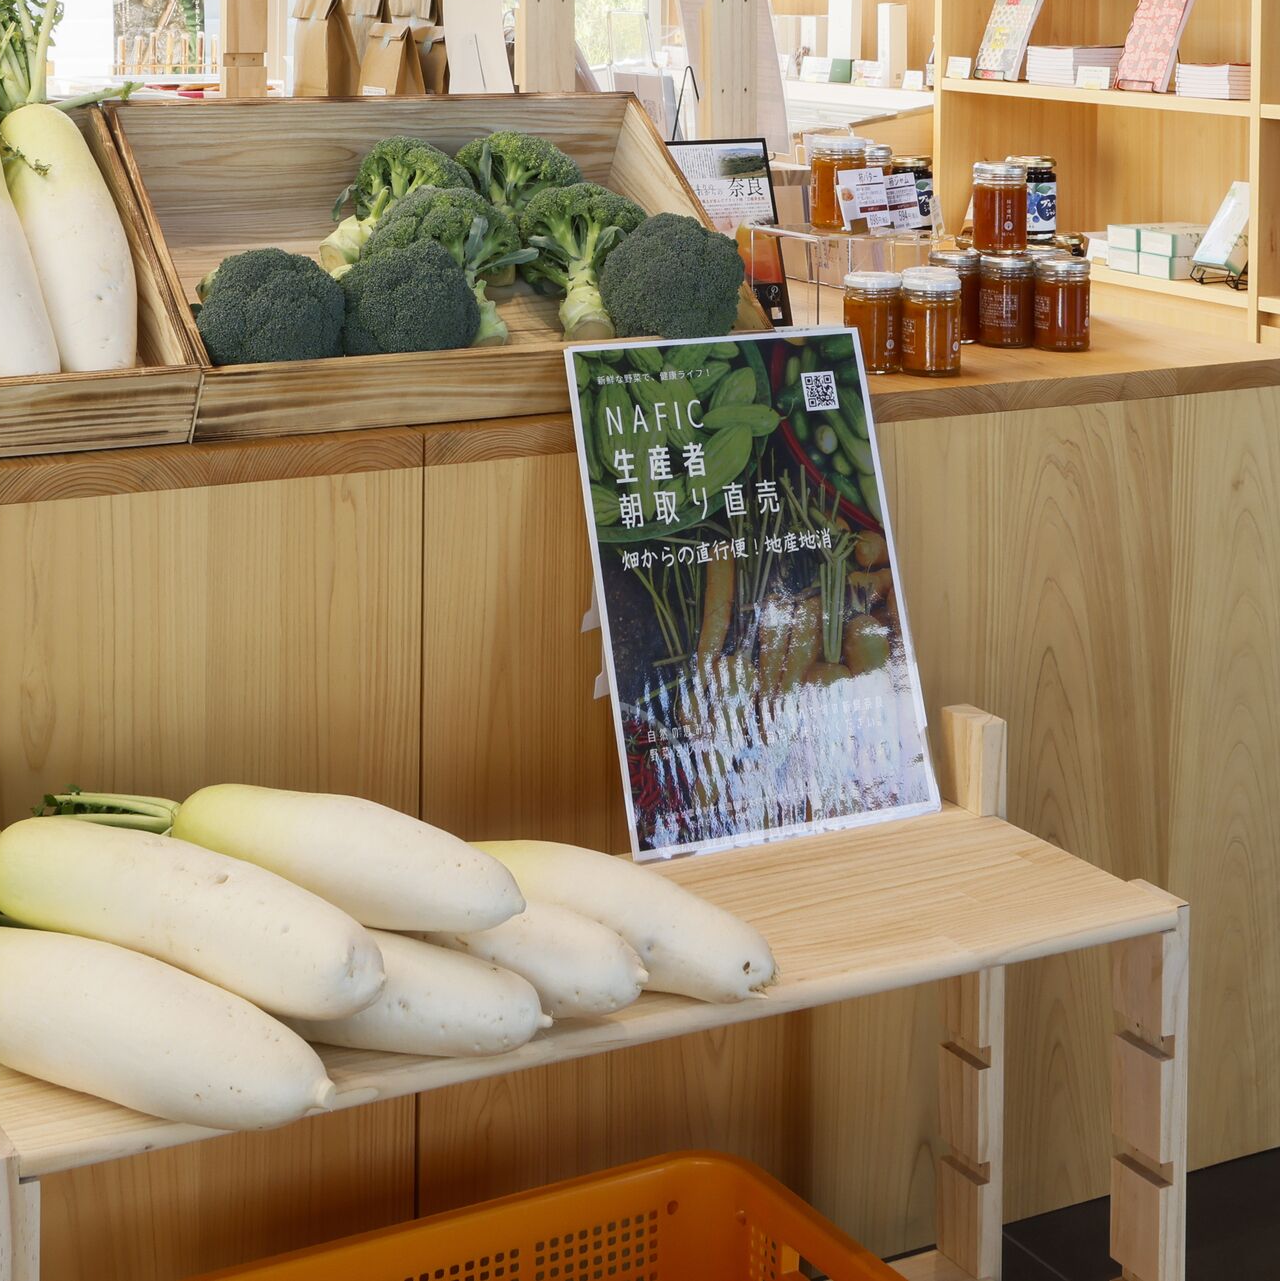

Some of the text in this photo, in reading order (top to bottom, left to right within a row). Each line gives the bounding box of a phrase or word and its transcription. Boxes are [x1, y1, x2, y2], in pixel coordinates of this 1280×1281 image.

[727, 177, 764, 198] 奈良
[605, 399, 706, 436] NAFIC
[613, 441, 708, 485] 生産者
[618, 479, 782, 530] 朝取り直売
[622, 527, 834, 572] 畑からの直行便！地産地消
